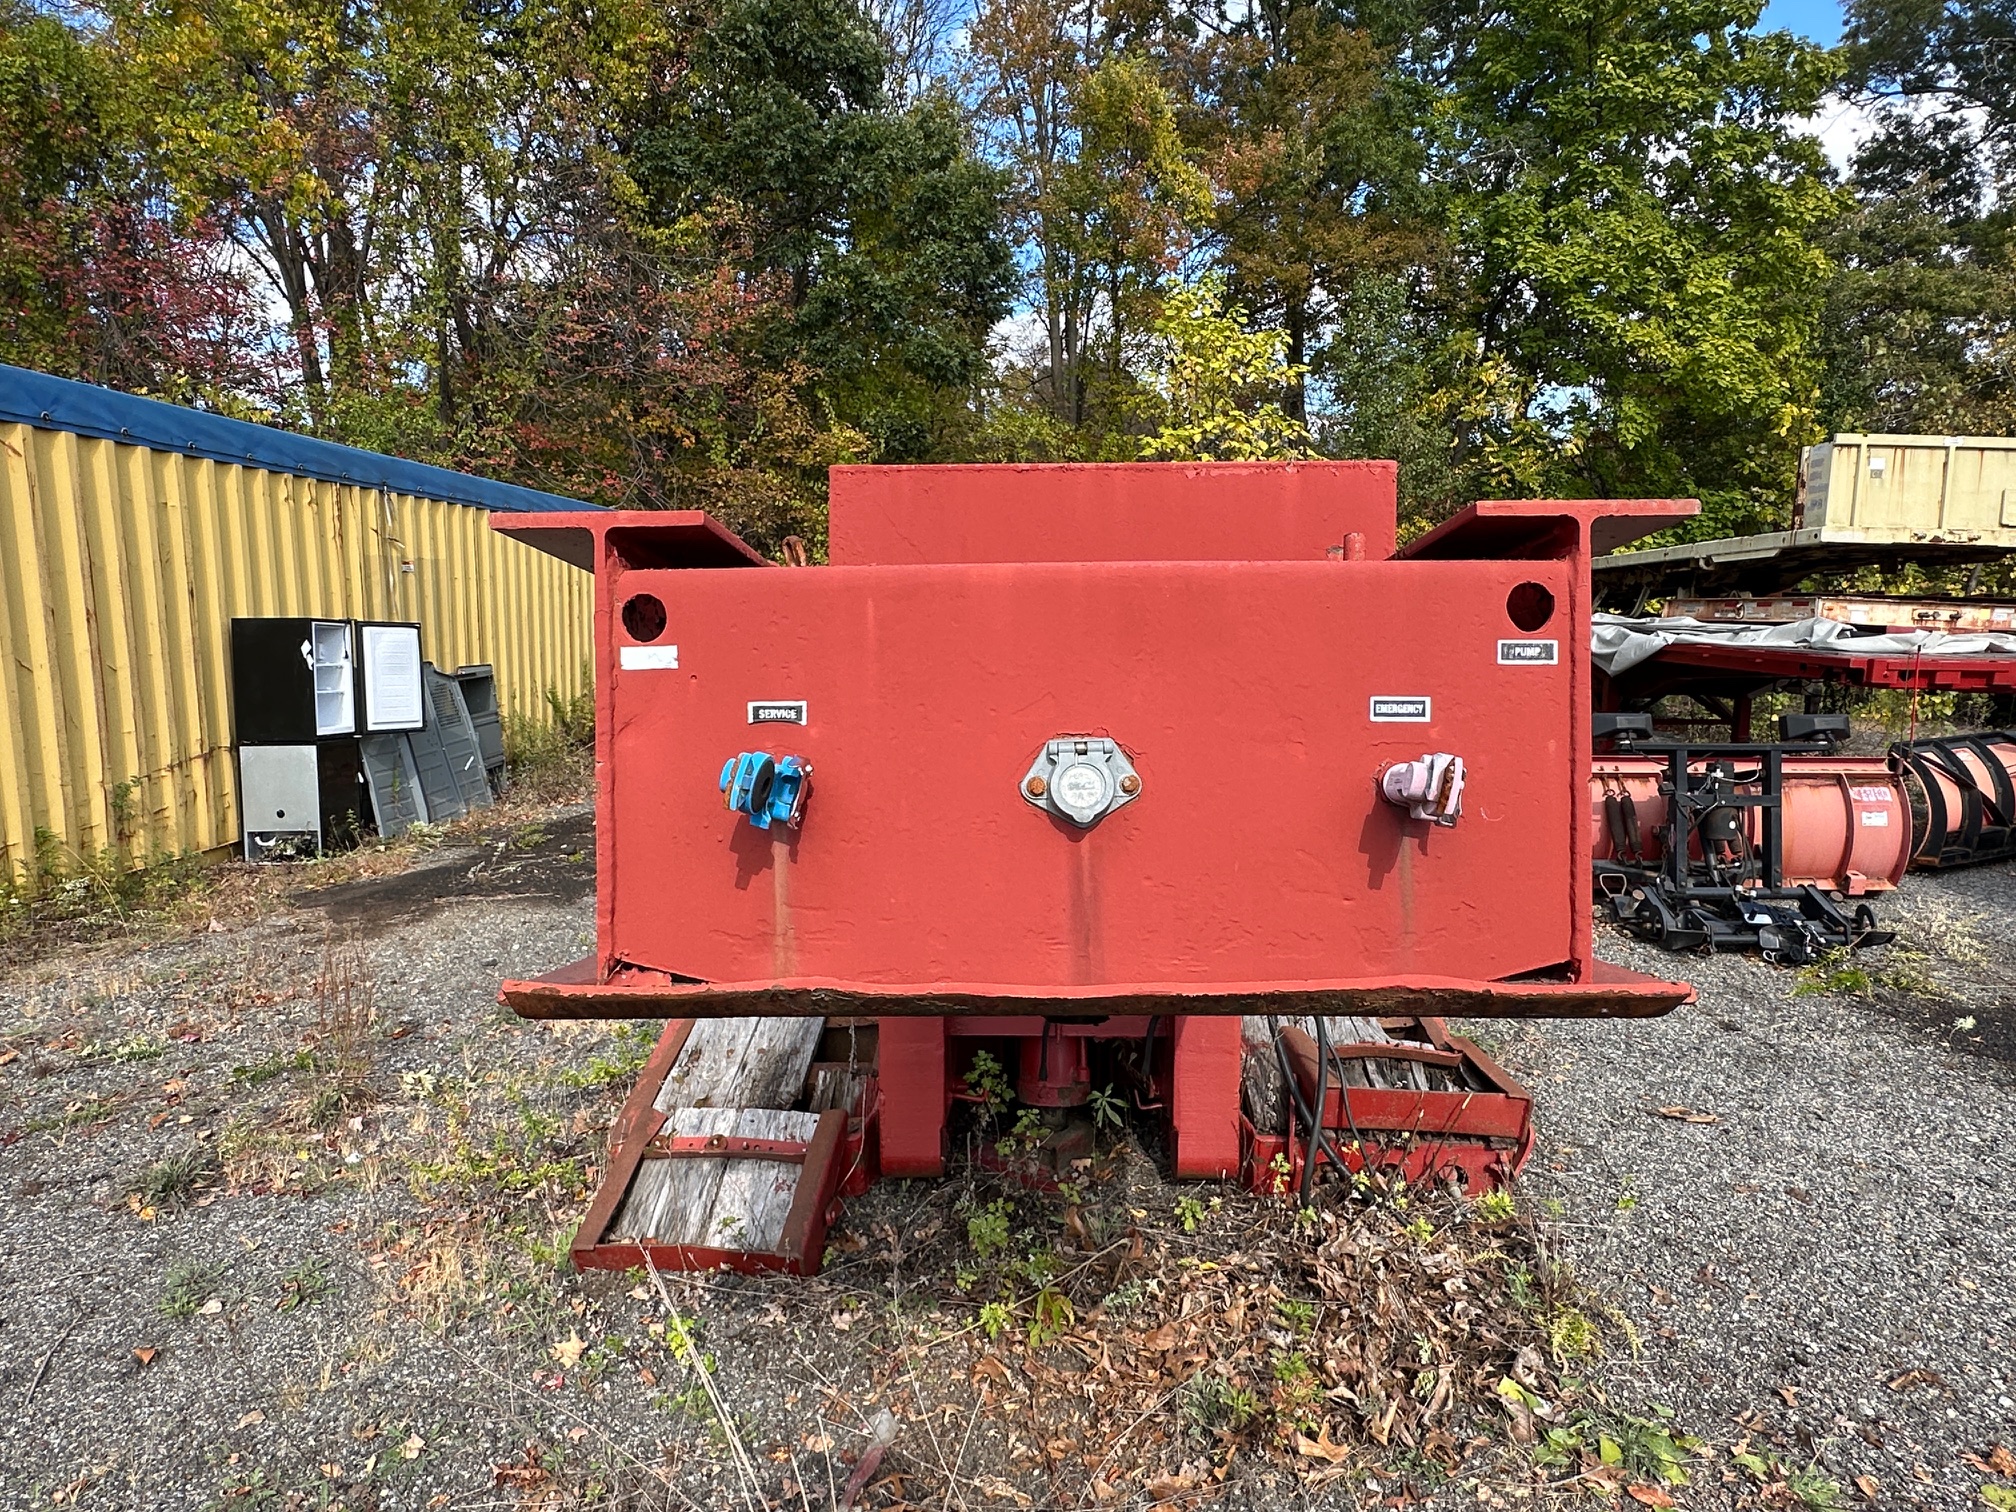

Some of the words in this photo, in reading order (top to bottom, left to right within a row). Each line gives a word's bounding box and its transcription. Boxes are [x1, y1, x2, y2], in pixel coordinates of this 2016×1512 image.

[1514, 646, 1541, 656] PUMP
[1375, 703, 1423, 714] EMERGENCY
[758, 709, 798, 719] SERVICE
